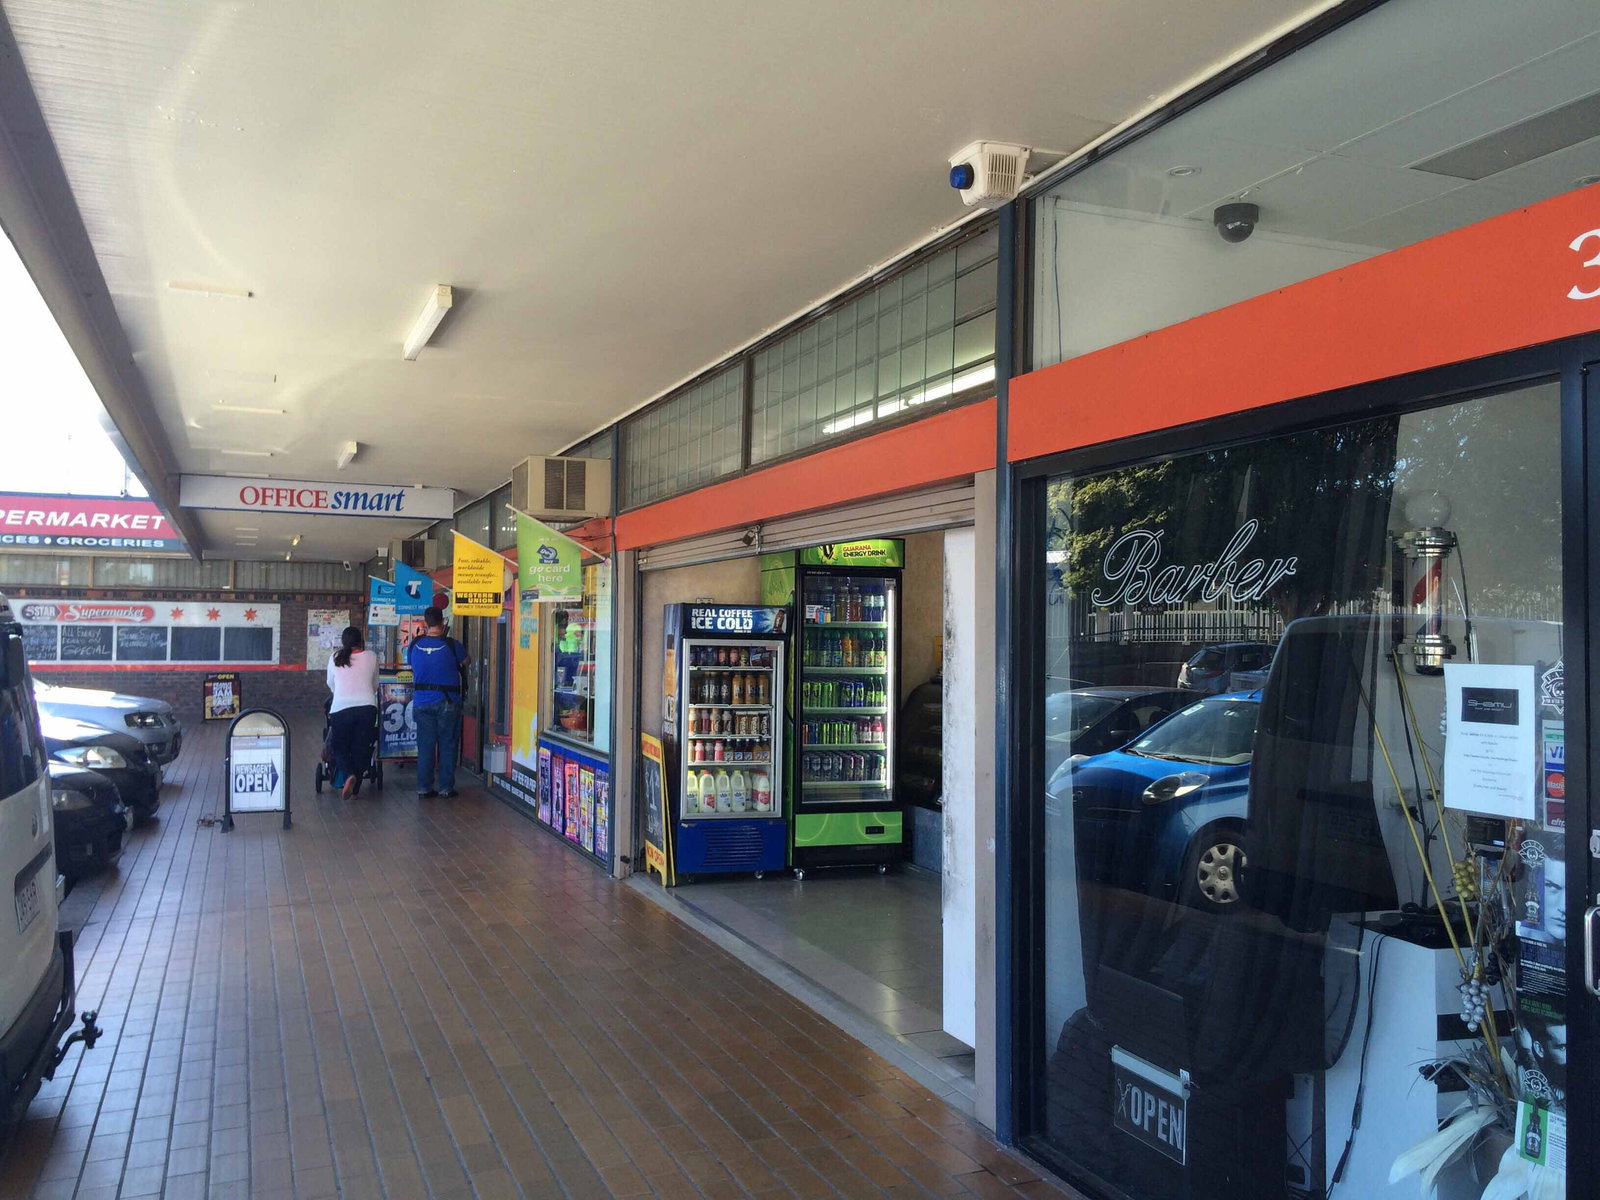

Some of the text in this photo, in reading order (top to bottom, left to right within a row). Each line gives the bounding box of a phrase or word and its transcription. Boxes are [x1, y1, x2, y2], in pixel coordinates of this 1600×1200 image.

[239, 486, 405, 513] OFFICE smart
[0, 535, 165, 547] CES GROCERIES
[529, 564, 570, 574] go card
[1091, 519, 1298, 607] Barber
[538, 574, 563, 583] here
[64, 604, 144, 620] Supermarket
[691, 608, 753, 618] REAL COFFEE
[691, 617, 753, 630] ICE COLD
[384, 732, 417, 742] MILLIO
[1550, 746, 1564, 759] VI
[235, 764, 272, 774] NEWSAGENT
[235, 774, 272, 792] OPEN
[1131, 1086, 1183, 1151] OPEN
